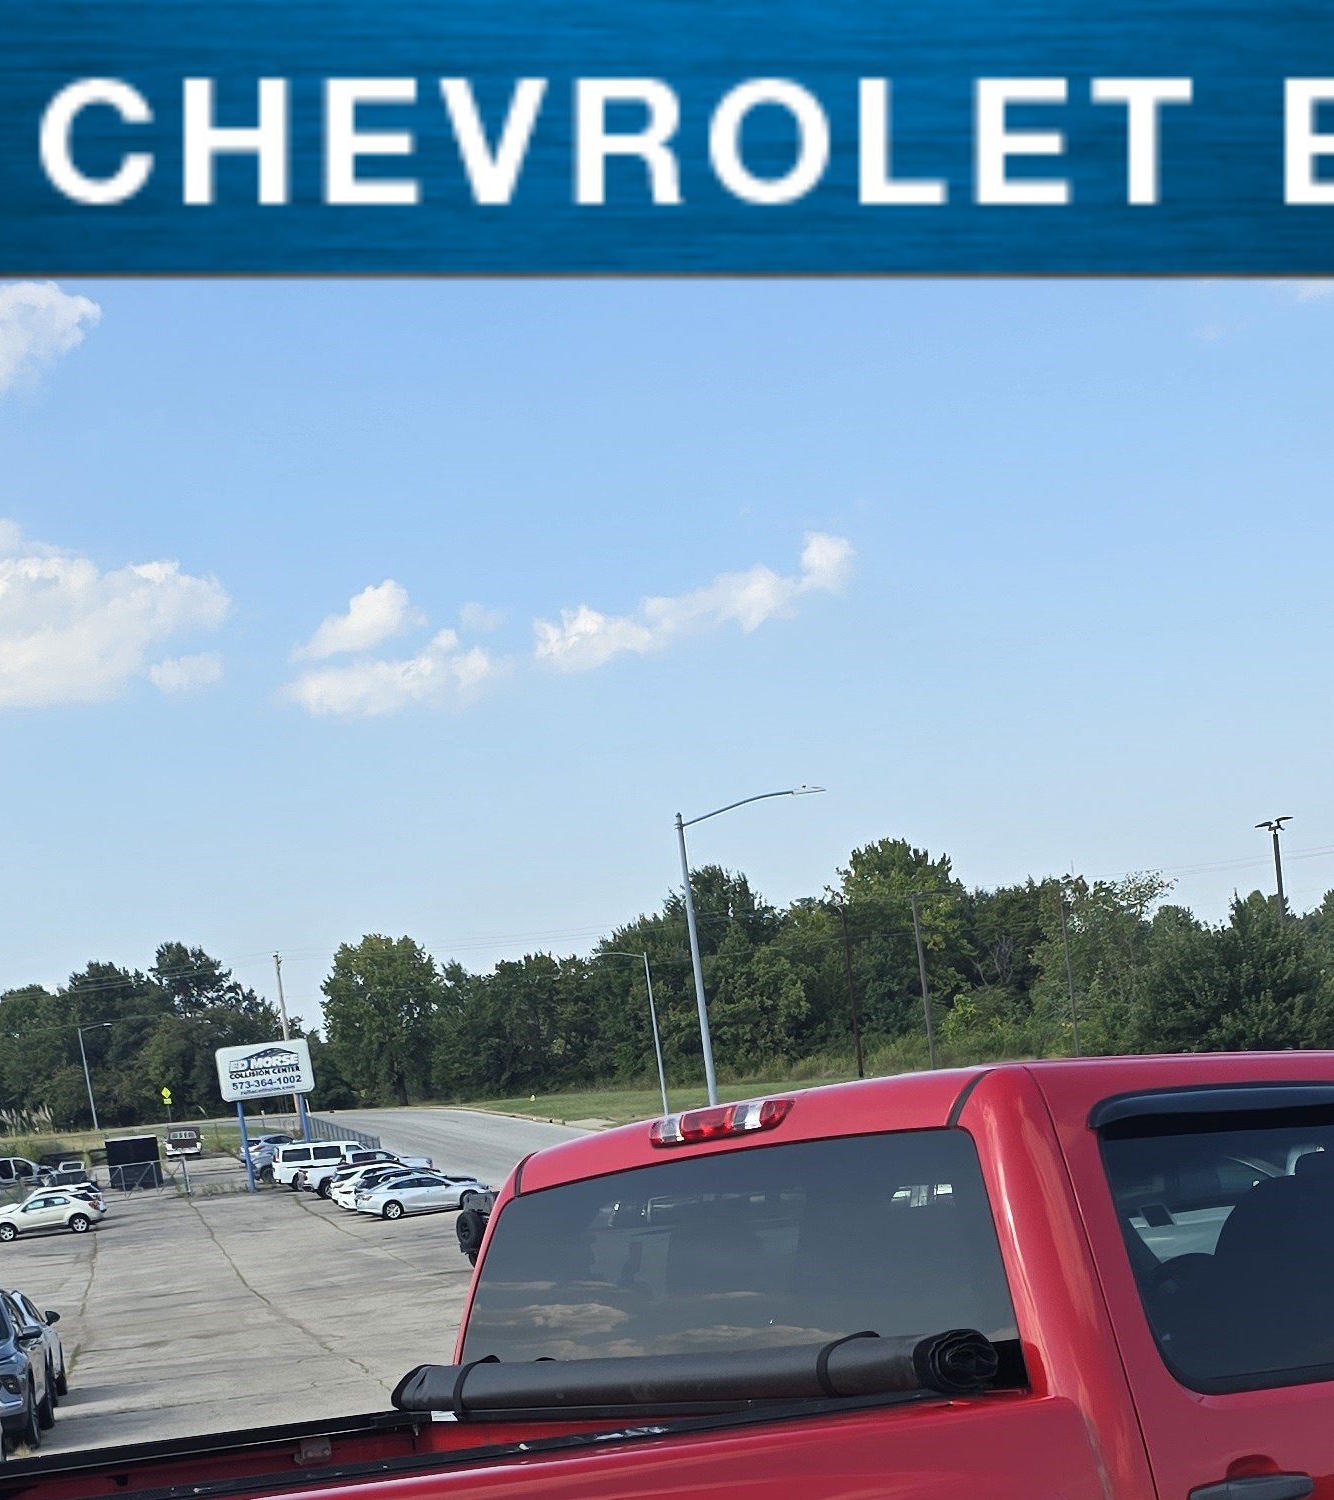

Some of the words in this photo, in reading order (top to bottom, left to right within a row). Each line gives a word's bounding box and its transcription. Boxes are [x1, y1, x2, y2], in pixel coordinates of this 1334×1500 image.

[229, 1060, 249, 1073] ED
[250, 1053, 299, 1071] MORSE
[229, 1069, 270, 1080] COLLISION
[272, 1065, 301, 1075] CENTER
[232, 1075, 302, 1091] 573-364-1002
